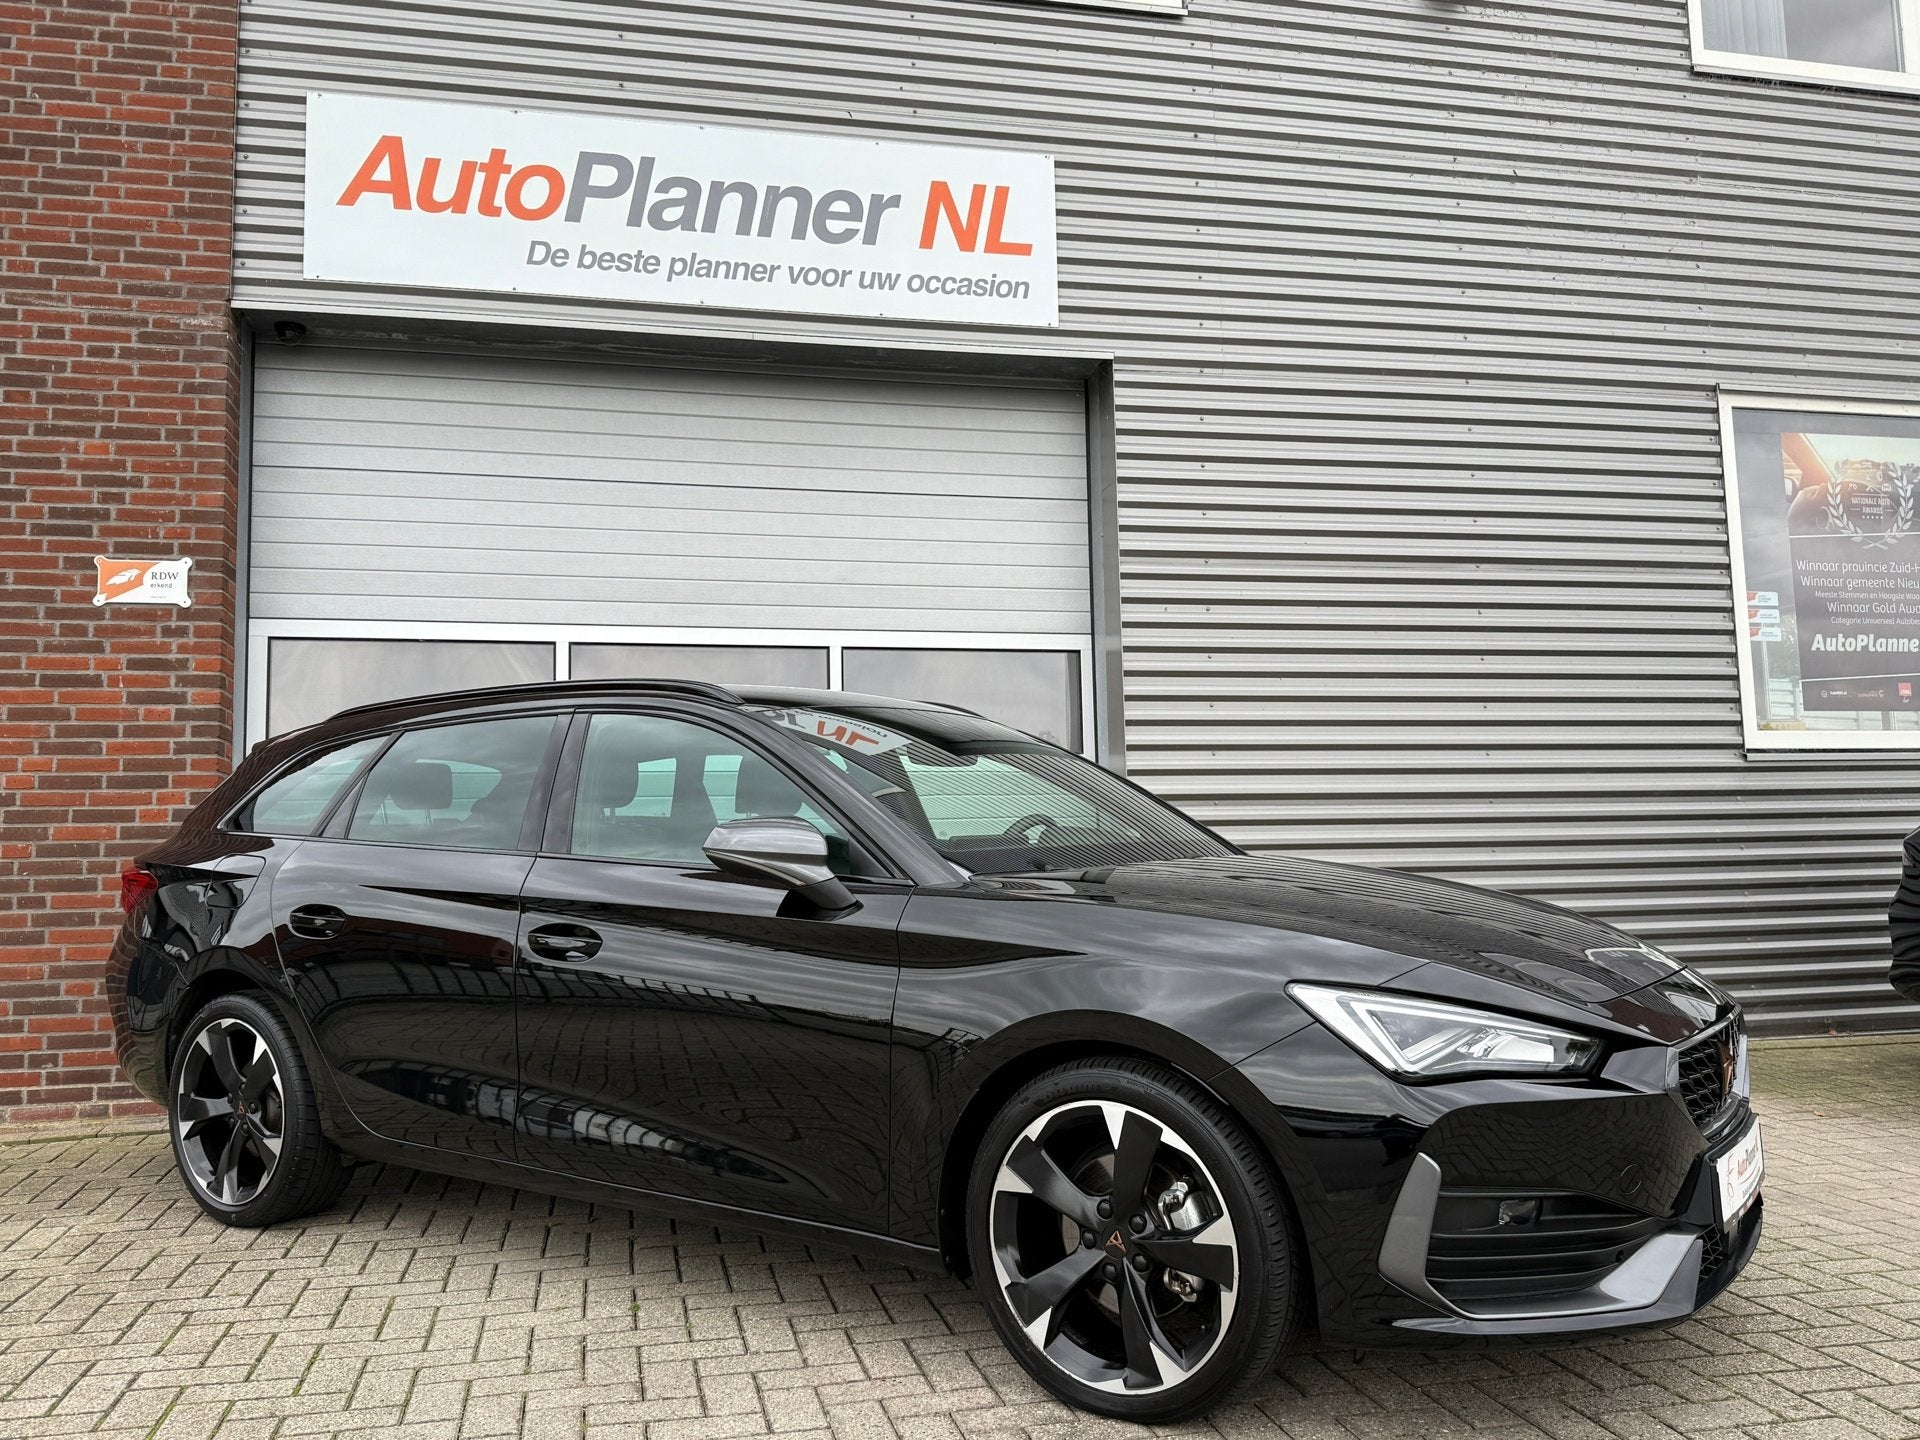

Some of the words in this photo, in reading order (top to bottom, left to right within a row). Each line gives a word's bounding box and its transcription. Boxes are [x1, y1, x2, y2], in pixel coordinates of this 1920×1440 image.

[336, 135, 901, 246] AutoPlanner
[919, 181, 1033, 256] NL
[526, 241, 569, 267] De
[577, 244, 660, 274] beste
[667, 253, 781, 283] planner
[788, 265, 852, 288] voor
[859, 271, 901, 290] uw
[907, 273, 1030, 299] occasion
[1796, 560, 1839, 571] Winnaar
[1842, 561, 1887, 574] provincie
[151, 571, 179, 580] RDW
[1801, 576, 1844, 587] Winnaar
[1846, 577, 1895, 590] gemeente
[1815, 591, 1838, 599] Meeste
[1839, 591, 1869, 599] Stemmen
[1879, 592, 1905, 601] Hoogste
[1827, 602, 1870, 613] Winnaar
[1872, 602, 1896, 614] Gold
[1831, 616, 1861, 626] Categorie
[1862, 616, 1895, 625] Universeel
[1811, 633, 1920, 653] AutoPlanne
